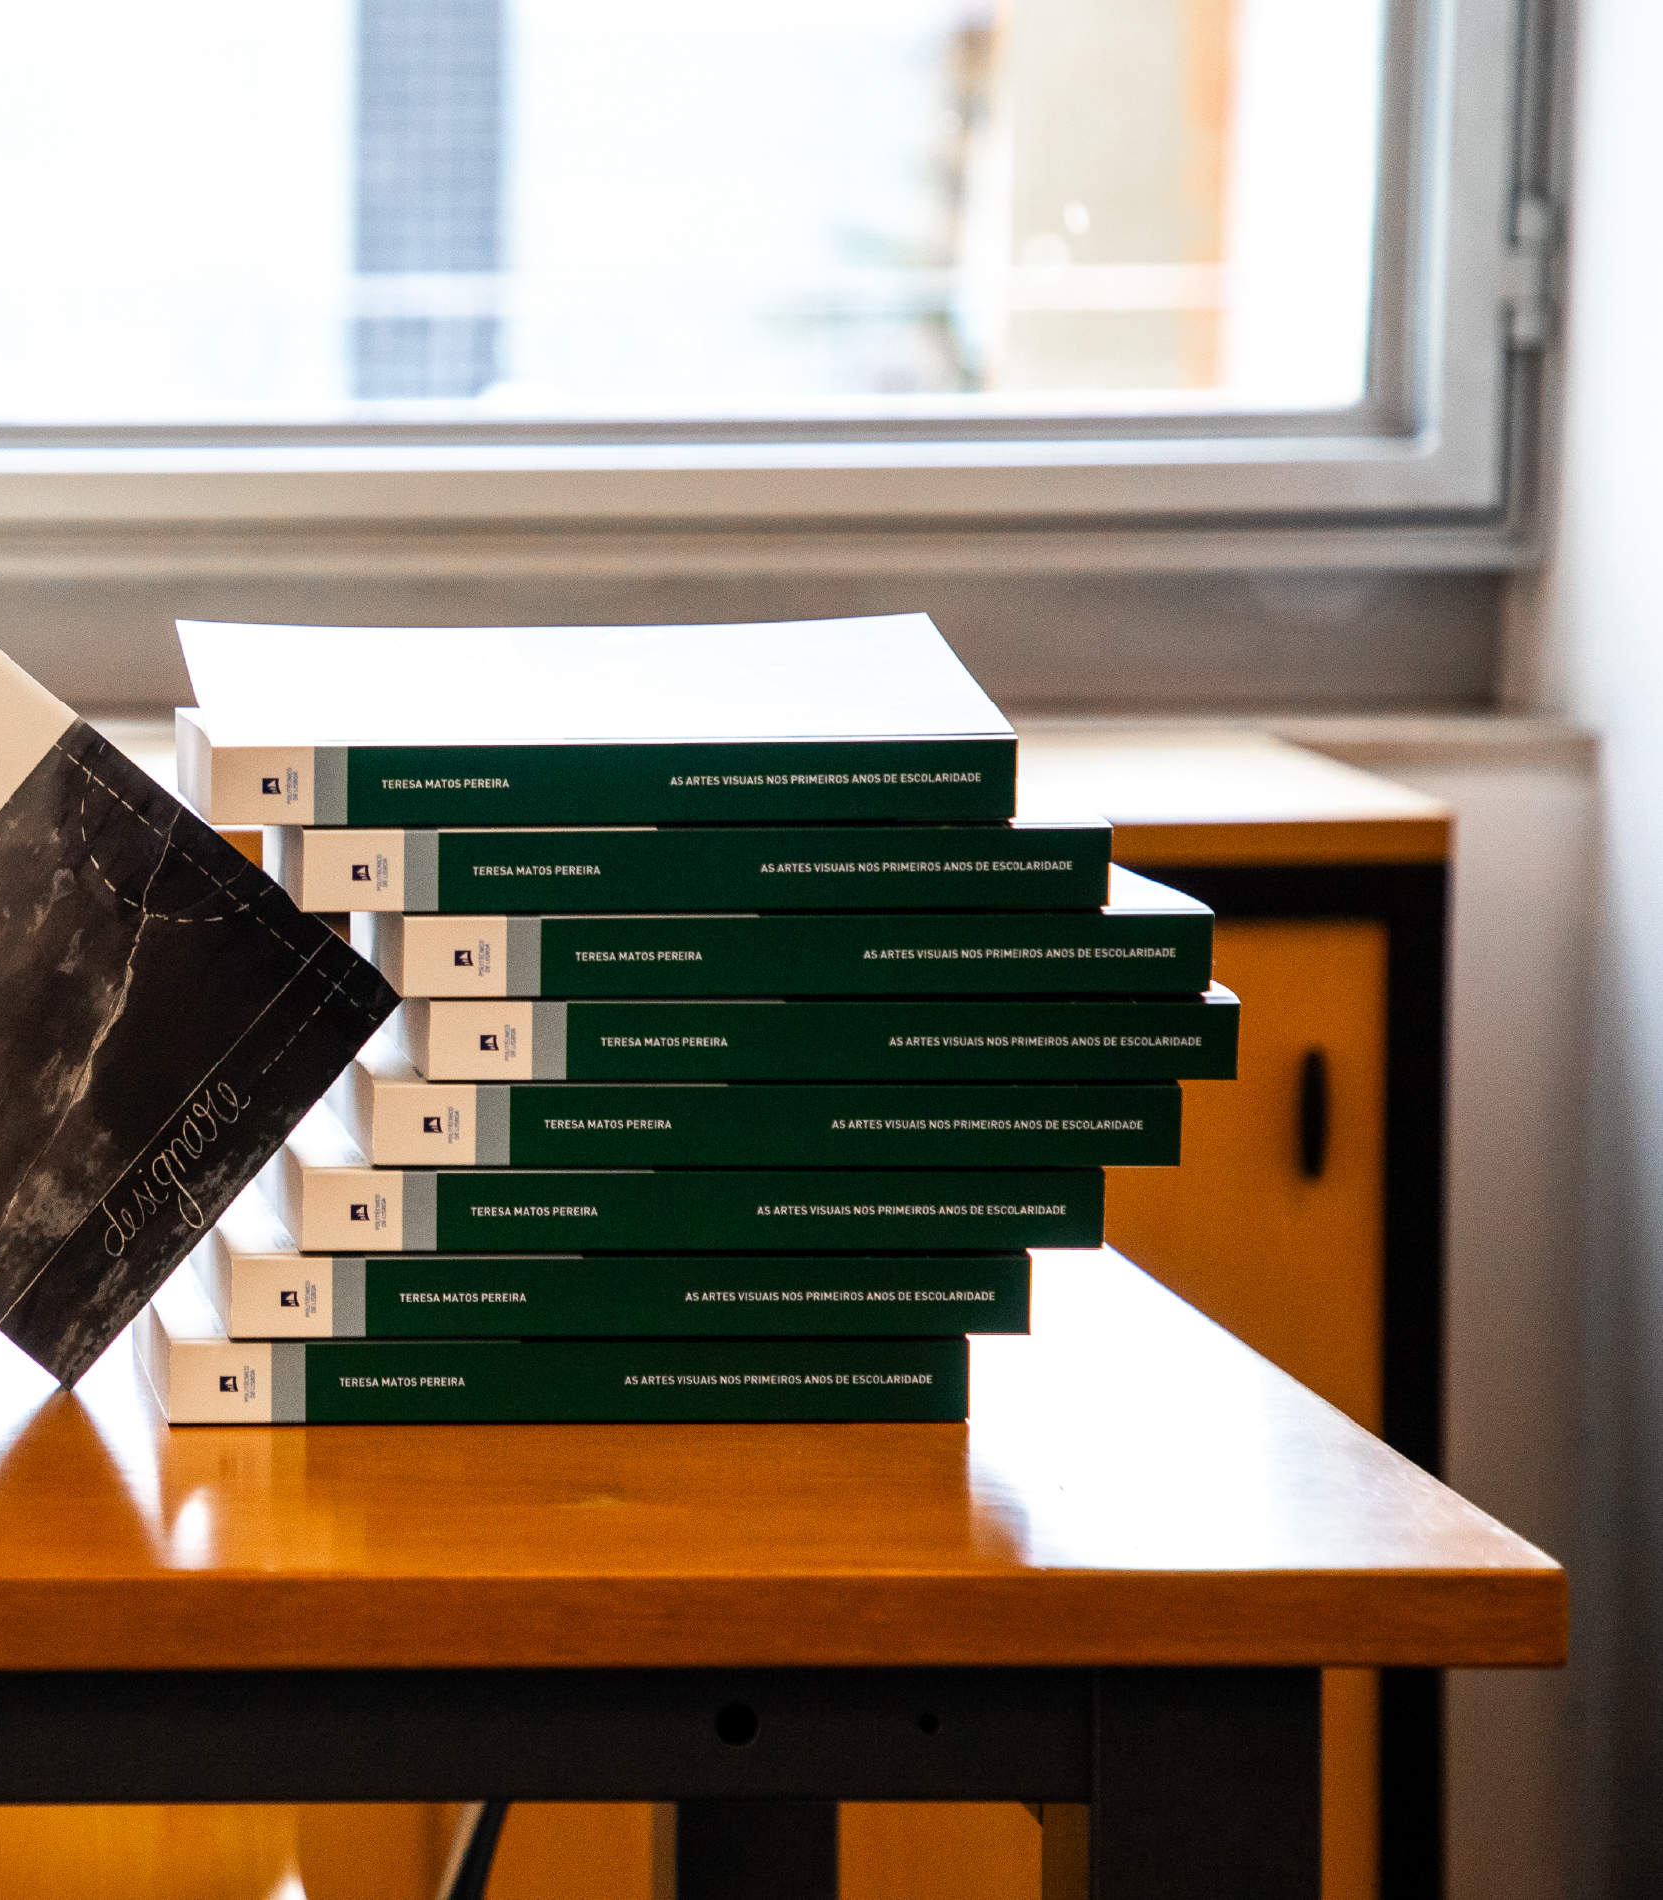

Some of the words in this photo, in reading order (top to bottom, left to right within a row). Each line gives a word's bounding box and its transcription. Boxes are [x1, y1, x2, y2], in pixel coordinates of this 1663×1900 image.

[381, 778, 424, 790] TERESA
[424, 778, 463, 789] MATOS
[462, 777, 510, 789] PEREIRA
[669, 775, 685, 787] AS
[684, 775, 721, 786] ARTES
[721, 774, 765, 786] VISUAIS
[765, 774, 789, 785] NOS
[789, 773, 850, 785] PRIMEIROS
[850, 773, 882, 784] ANOS
[882, 772, 898, 784] DE
[899, 771, 981, 784] ESCOLARIDADE
[472, 865, 515, 877] TERESA
[515, 864, 553, 876] MATOS
[554, 864, 602, 876] PEREIRA
[574, 950, 617, 962] TERESA
[617, 950, 656, 962] MATOS
[656, 950, 703, 962] PEREIRA
[862, 949, 879, 960] AS
[878, 948, 916, 960] ARTES
[916, 948, 960, 960] VISUAIS
[959, 948, 984, 960] NOS
[984, 947, 1044, 959] PRIMEIROS
[1044, 947, 1076, 959] ANOS
[1076, 947, 1092, 959] DE
[1093, 947, 1176, 959] ESCOLARIDADE
[600, 1036, 643, 1048] TERESA
[643, 1036, 681, 1048] MATOS
[681, 1036, 729, 1048] PEREIRA
[543, 1118, 586, 1130] TERESA
[586, 1118, 625, 1130] MATOS
[625, 1118, 673, 1130] PEREIRA
[830, 1118, 847, 1130] AS
[847, 1118, 884, 1130] ARTES
[884, 1118, 927, 1130] VISUAIS
[927, 1119, 952, 1130] NOS
[952, 1118, 1013, 1131] PRIMEIROS
[1013, 1119, 1044, 1130] ANOS
[1044, 1119, 1060, 1131] DE
[1061, 1119, 1144, 1131] ESCOLARIDADE
[104, 1081, 251, 1258] designare
[470, 1205, 512, 1218] TERESA
[513, 1205, 551, 1217] MATOS
[551, 1205, 599, 1217] PEREIRA
[756, 1205, 772, 1216] AS
[772, 1204, 809, 1216] ARTES
[808, 1205, 852, 1216] VISUAIS
[852, 1204, 876, 1216] NOS
[876, 1204, 937, 1216] PRIMEIROS
[937, 1204, 969, 1216] ANOS
[969, 1204, 984, 1216] DE
[986, 1204, 1067, 1216] ESCOLARIDADE
[399, 1292, 441, 1304] TERESA
[441, 1292, 480, 1303] MATOS
[480, 1292, 527, 1303] PEREIRA
[339, 1376, 380, 1388] TERESA
[380, 1376, 418, 1388] MATOS
[419, 1376, 466, 1388] PEREIRA
[623, 1375, 640, 1386] AS
[640, 1374, 676, 1386] ARTES
[676, 1374, 718, 1386] VISUAIS
[718, 1374, 742, 1385] NOS
[743, 1374, 803, 1385] PRIMEIROS
[803, 1374, 834, 1385] ANOS
[834, 1374, 850, 1385] DE
[851, 1373, 933, 1385] ESCOLARIDADE
